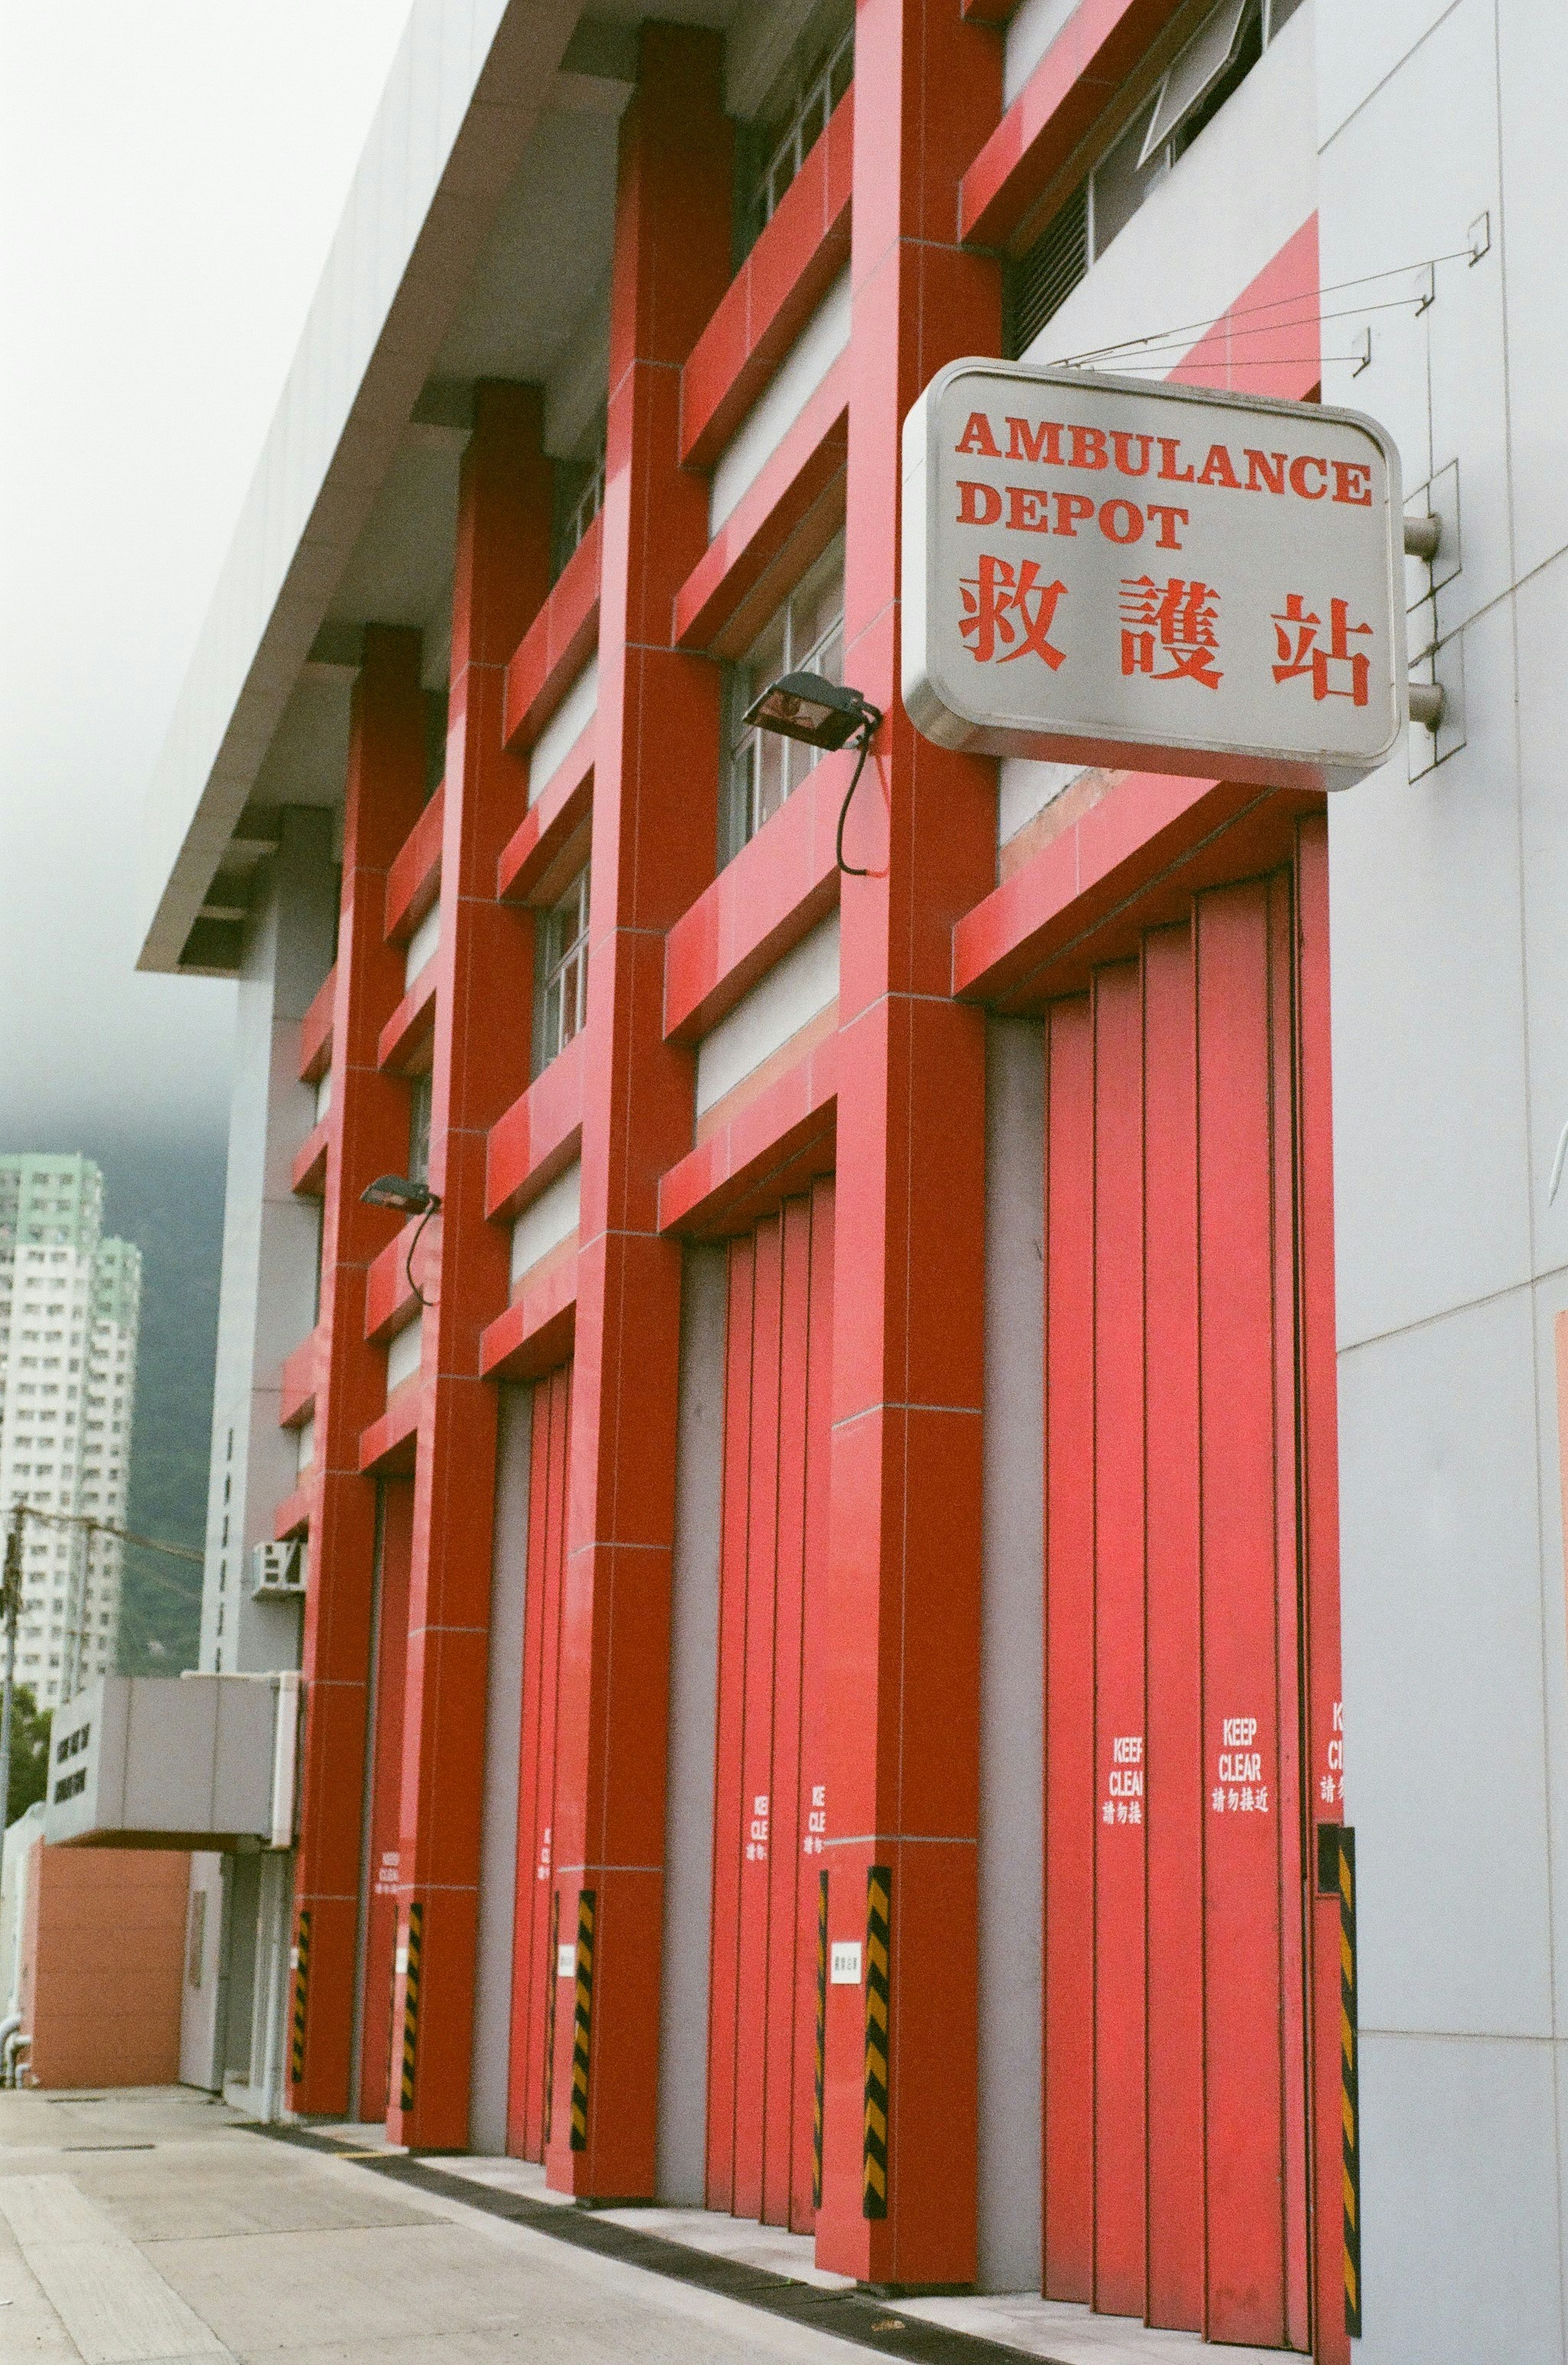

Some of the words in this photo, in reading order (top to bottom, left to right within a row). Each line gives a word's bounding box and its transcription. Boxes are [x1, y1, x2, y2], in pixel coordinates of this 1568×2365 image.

[955, 411, 1373, 508] AMBULANCE
[955, 480, 1191, 550] DEPOT
[958, 553, 1374, 707] 救護站
[1223, 1717, 1258, 1746] KEEP
[1218, 1753, 1262, 1782] CLEAR
[1211, 1785, 1269, 1813] 請勿接近
